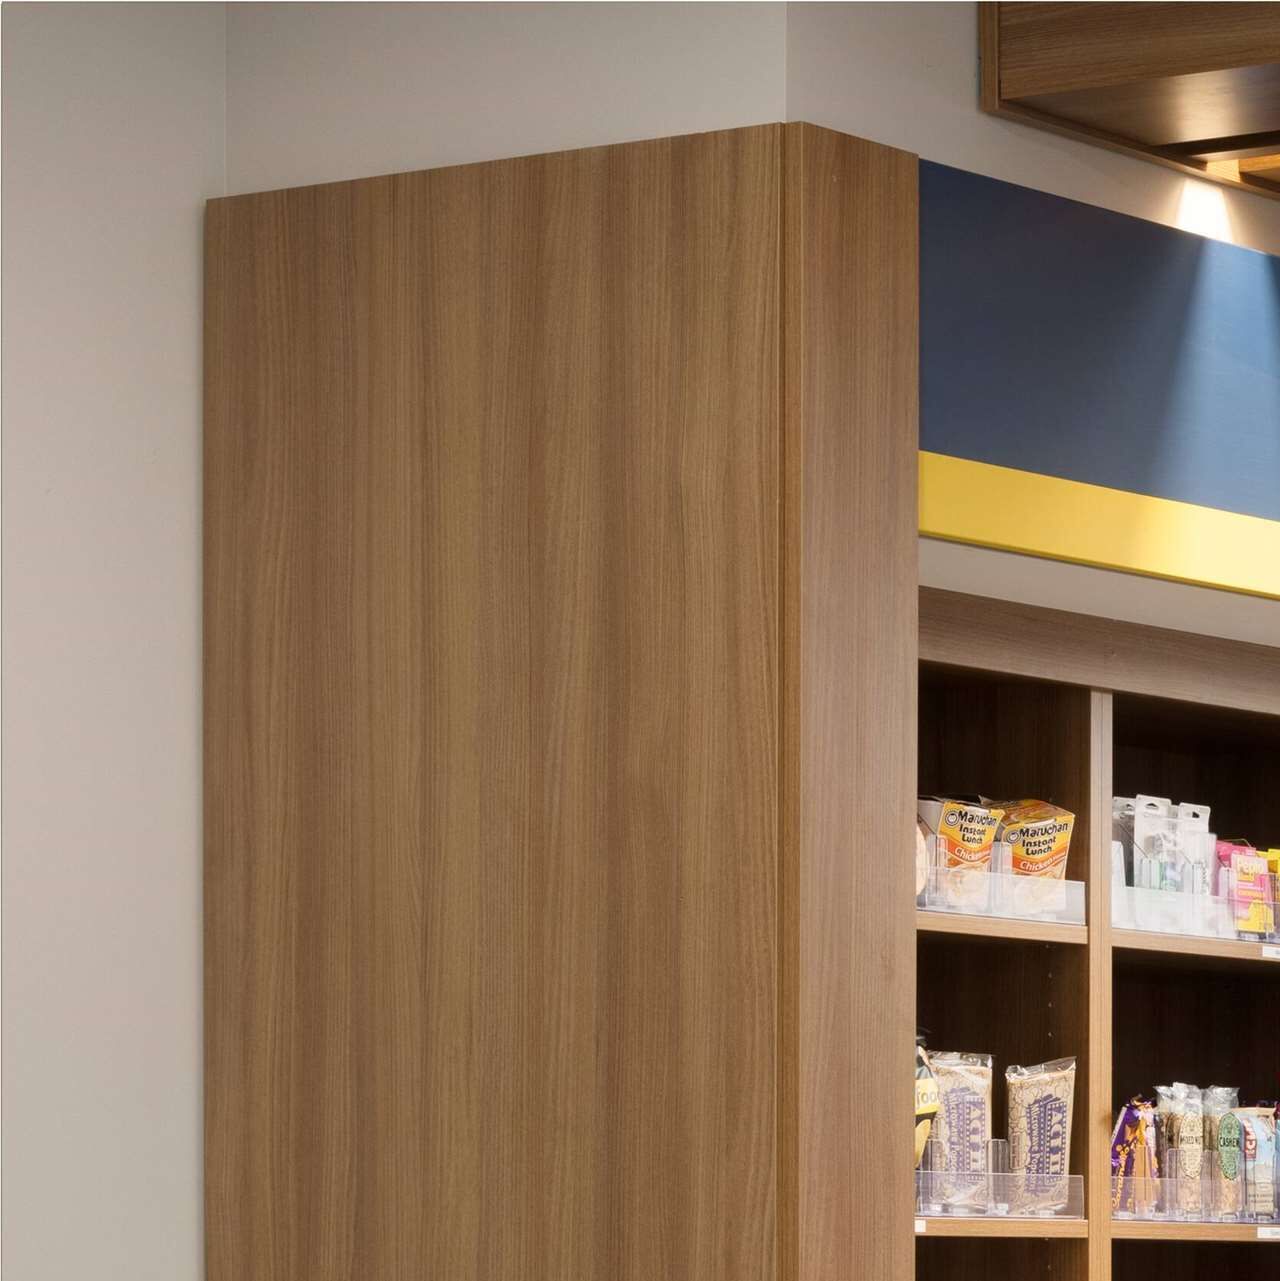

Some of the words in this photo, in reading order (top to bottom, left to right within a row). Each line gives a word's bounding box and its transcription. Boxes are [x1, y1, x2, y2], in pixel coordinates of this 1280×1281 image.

[1020, 823, 1069, 838] Maruchan
[1022, 836, 1056, 848] Instant
[1026, 845, 1053, 856] Lunch
